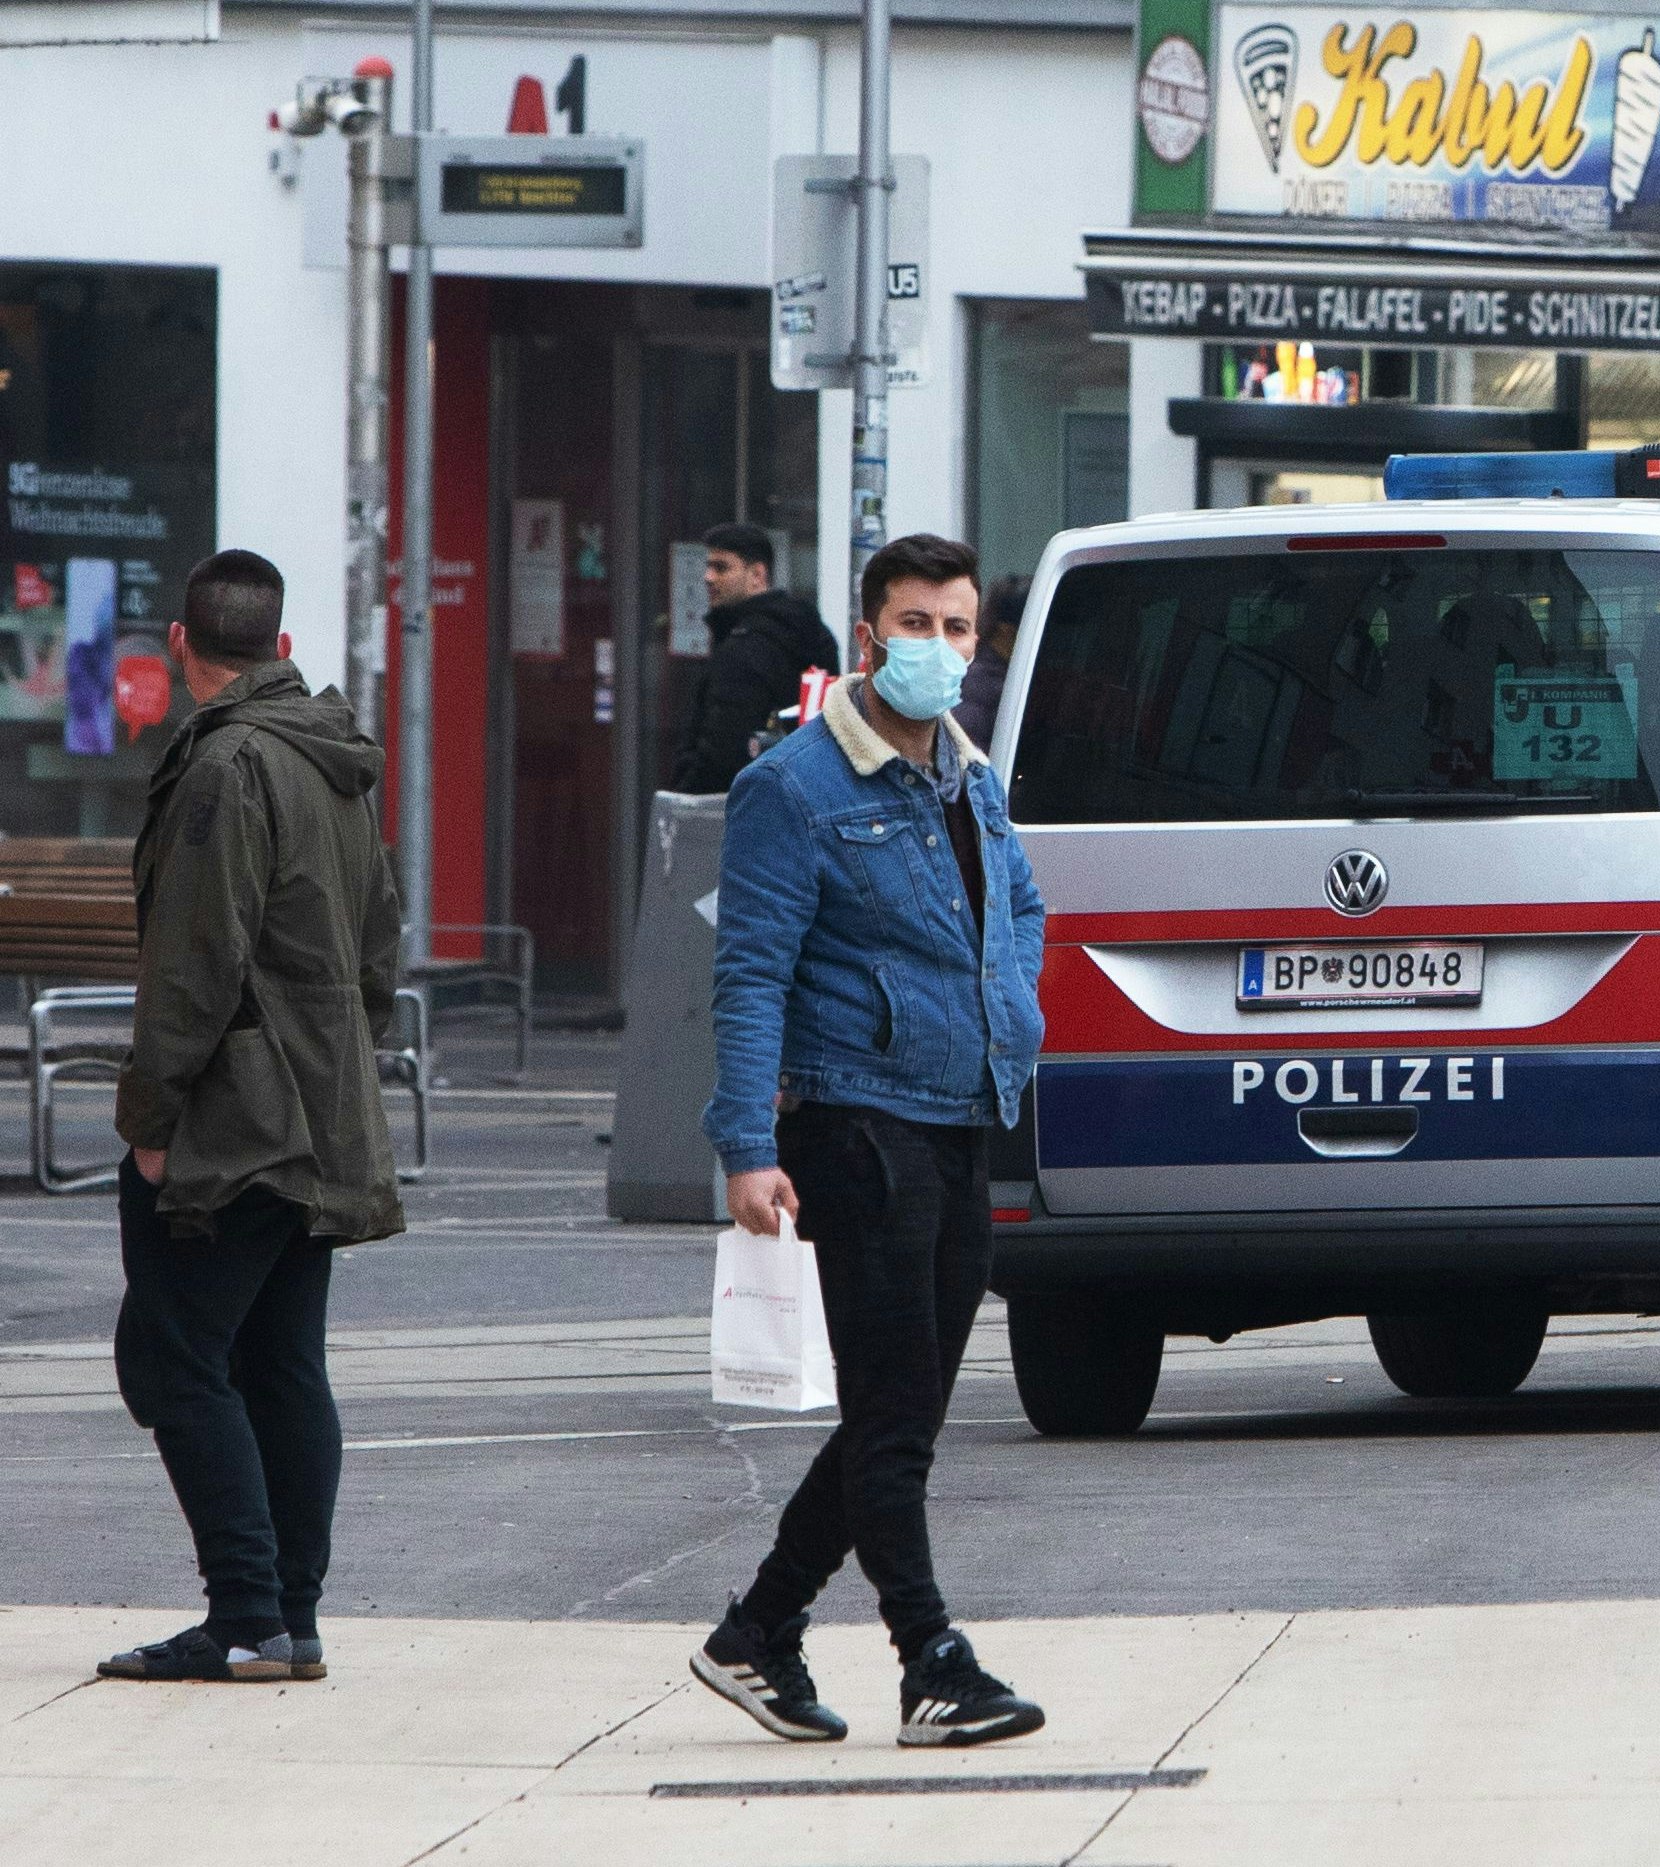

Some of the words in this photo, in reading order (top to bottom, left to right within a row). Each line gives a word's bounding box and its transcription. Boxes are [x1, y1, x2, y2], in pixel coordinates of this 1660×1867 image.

[1295, 20, 1591, 170] Kabul
[888, 267, 917, 295] U5
[1121, 281, 1206, 324] KEBAP
[1228, 283, 1299, 327] PIZZA
[1317, 286, 1428, 333] FALAFEL
[1449, 290, 1508, 334] PIDE
[1544, 706, 1582, 730] U
[1522, 735, 1602, 763] 132
[1275, 956, 1318, 990] BP
[1349, 953, 1462, 989] 90848
[1232, 1057, 1504, 1104] POLIZEI
